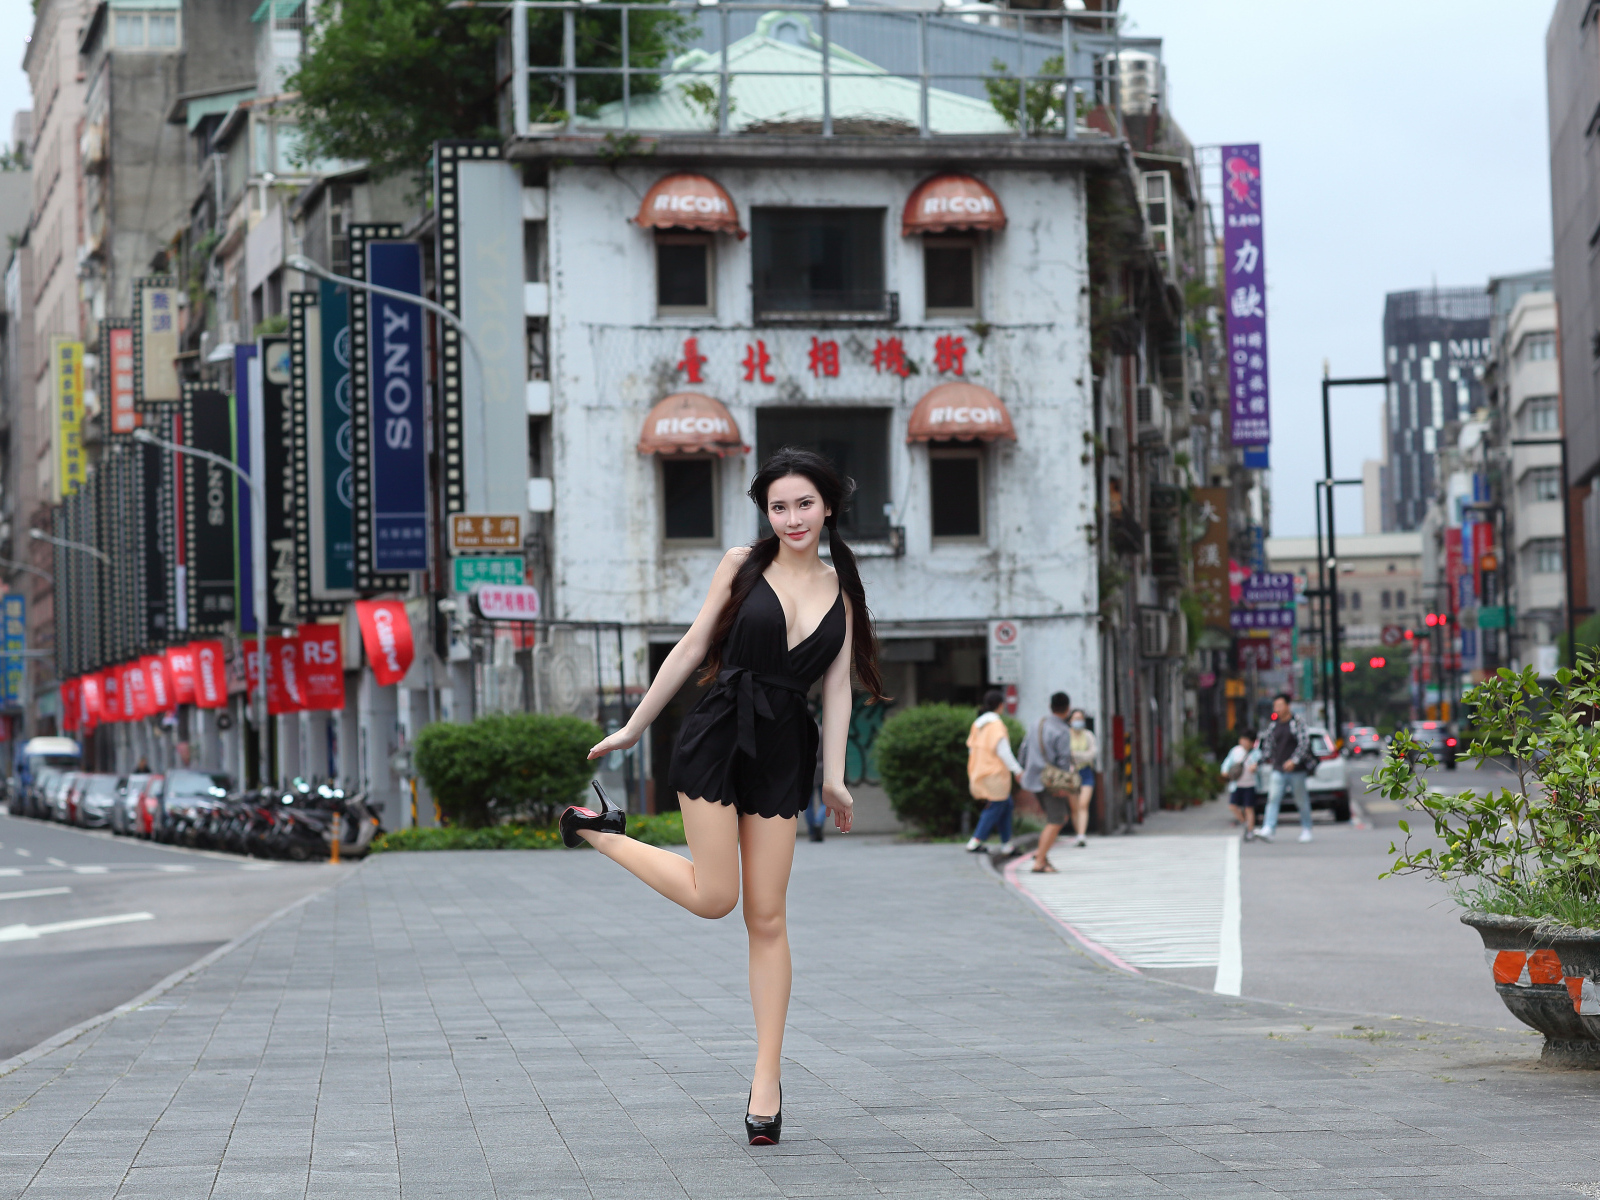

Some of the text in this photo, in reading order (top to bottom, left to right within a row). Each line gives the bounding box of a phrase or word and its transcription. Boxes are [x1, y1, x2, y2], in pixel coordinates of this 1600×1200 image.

[653, 194, 729, 214] RICOH
[923, 195, 997, 214] RICOH
[1231, 239, 1264, 318] 力歐
[383, 303, 412, 450] SONY
[677, 334, 968, 384] 臺北相機街
[1233, 333, 1249, 415] HOTEL
[655, 416, 730, 435] RICOH
[929, 406, 1003, 424] RICOH
[302, 640, 338, 665] R5
[373, 608, 401, 672] Canon
[199, 648, 217, 701] Canon
